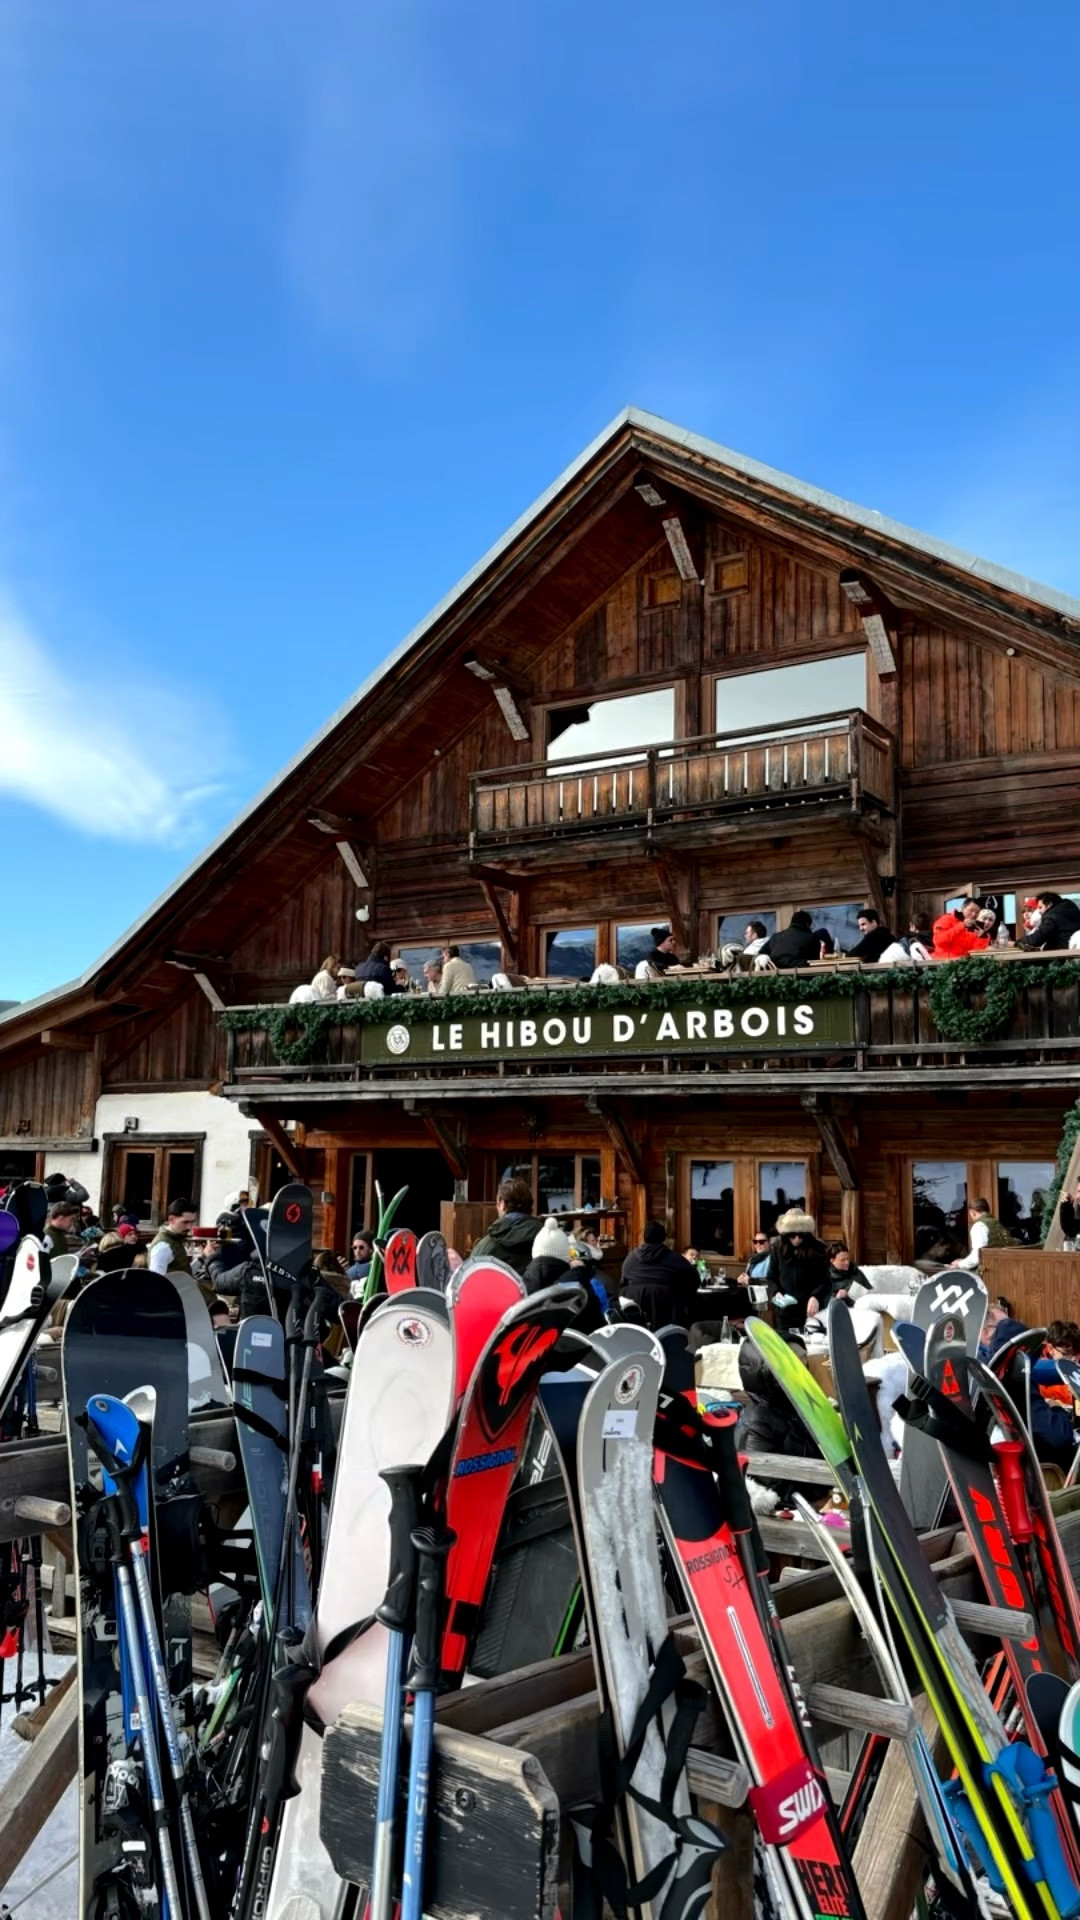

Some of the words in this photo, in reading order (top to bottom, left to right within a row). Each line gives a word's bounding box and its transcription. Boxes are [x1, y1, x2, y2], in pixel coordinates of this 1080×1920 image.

[432, 1024, 463, 1051] LE
[480, 1016, 592, 1048] HIBOU
[786, 1664, 812, 1728] LEKI
[252, 1845, 273, 1920] GIPRO
